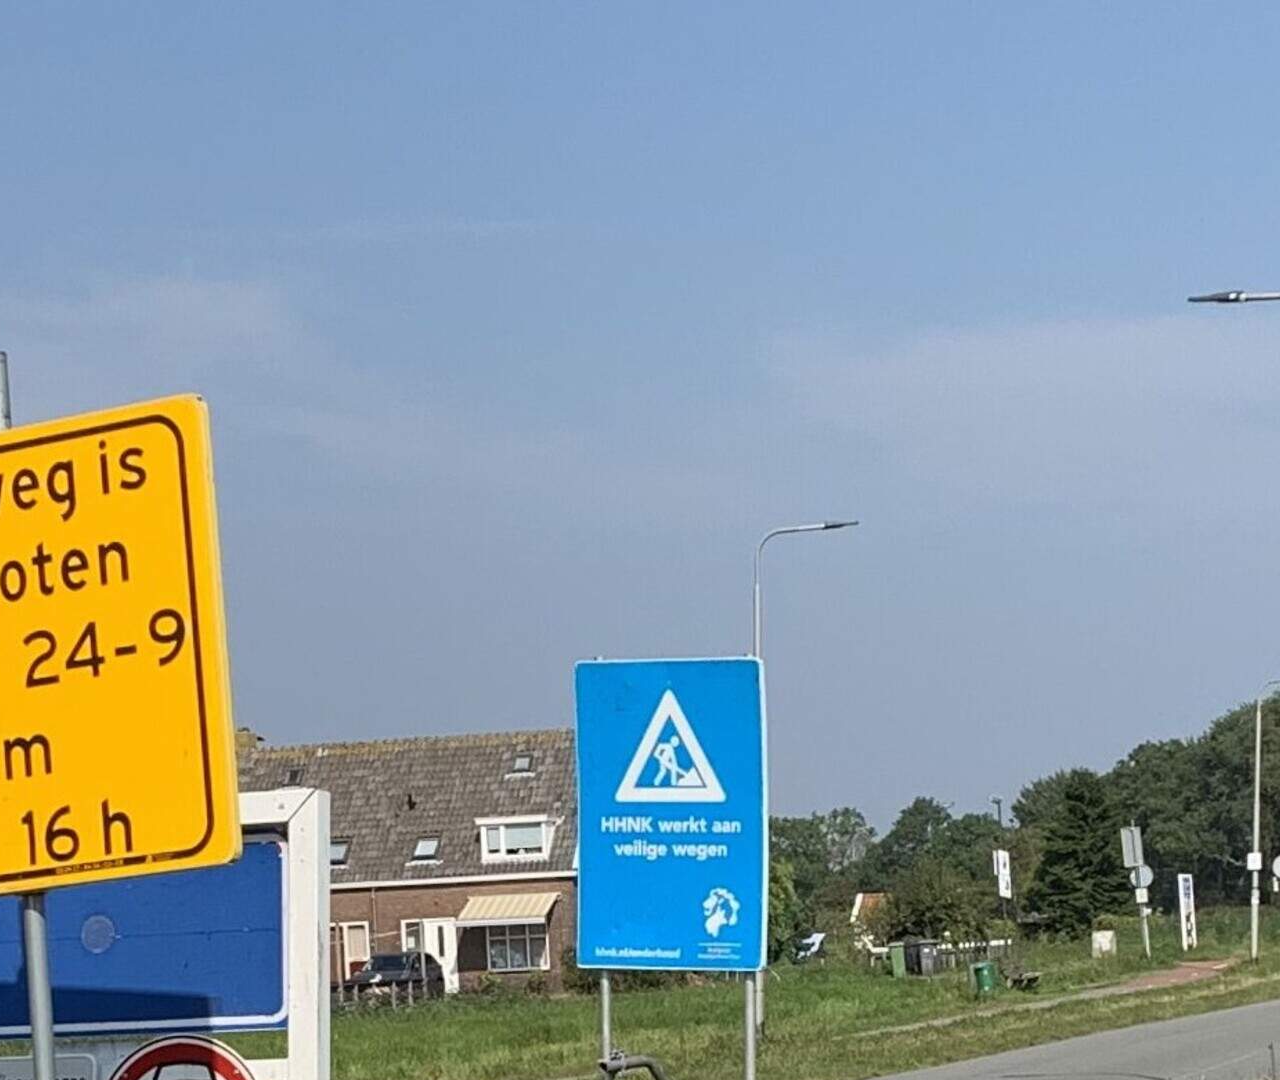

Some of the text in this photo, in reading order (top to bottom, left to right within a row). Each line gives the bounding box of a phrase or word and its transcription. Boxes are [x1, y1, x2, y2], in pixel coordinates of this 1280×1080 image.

[98, 440, 147, 495] is
[23, 608, 186, 689] 24-9
[21, 805, 80, 866] 16
[101, 799, 133, 856] h
[600, 816, 742, 833] HHNK werkt aan
[613, 840, 728, 860] veilige wegen
